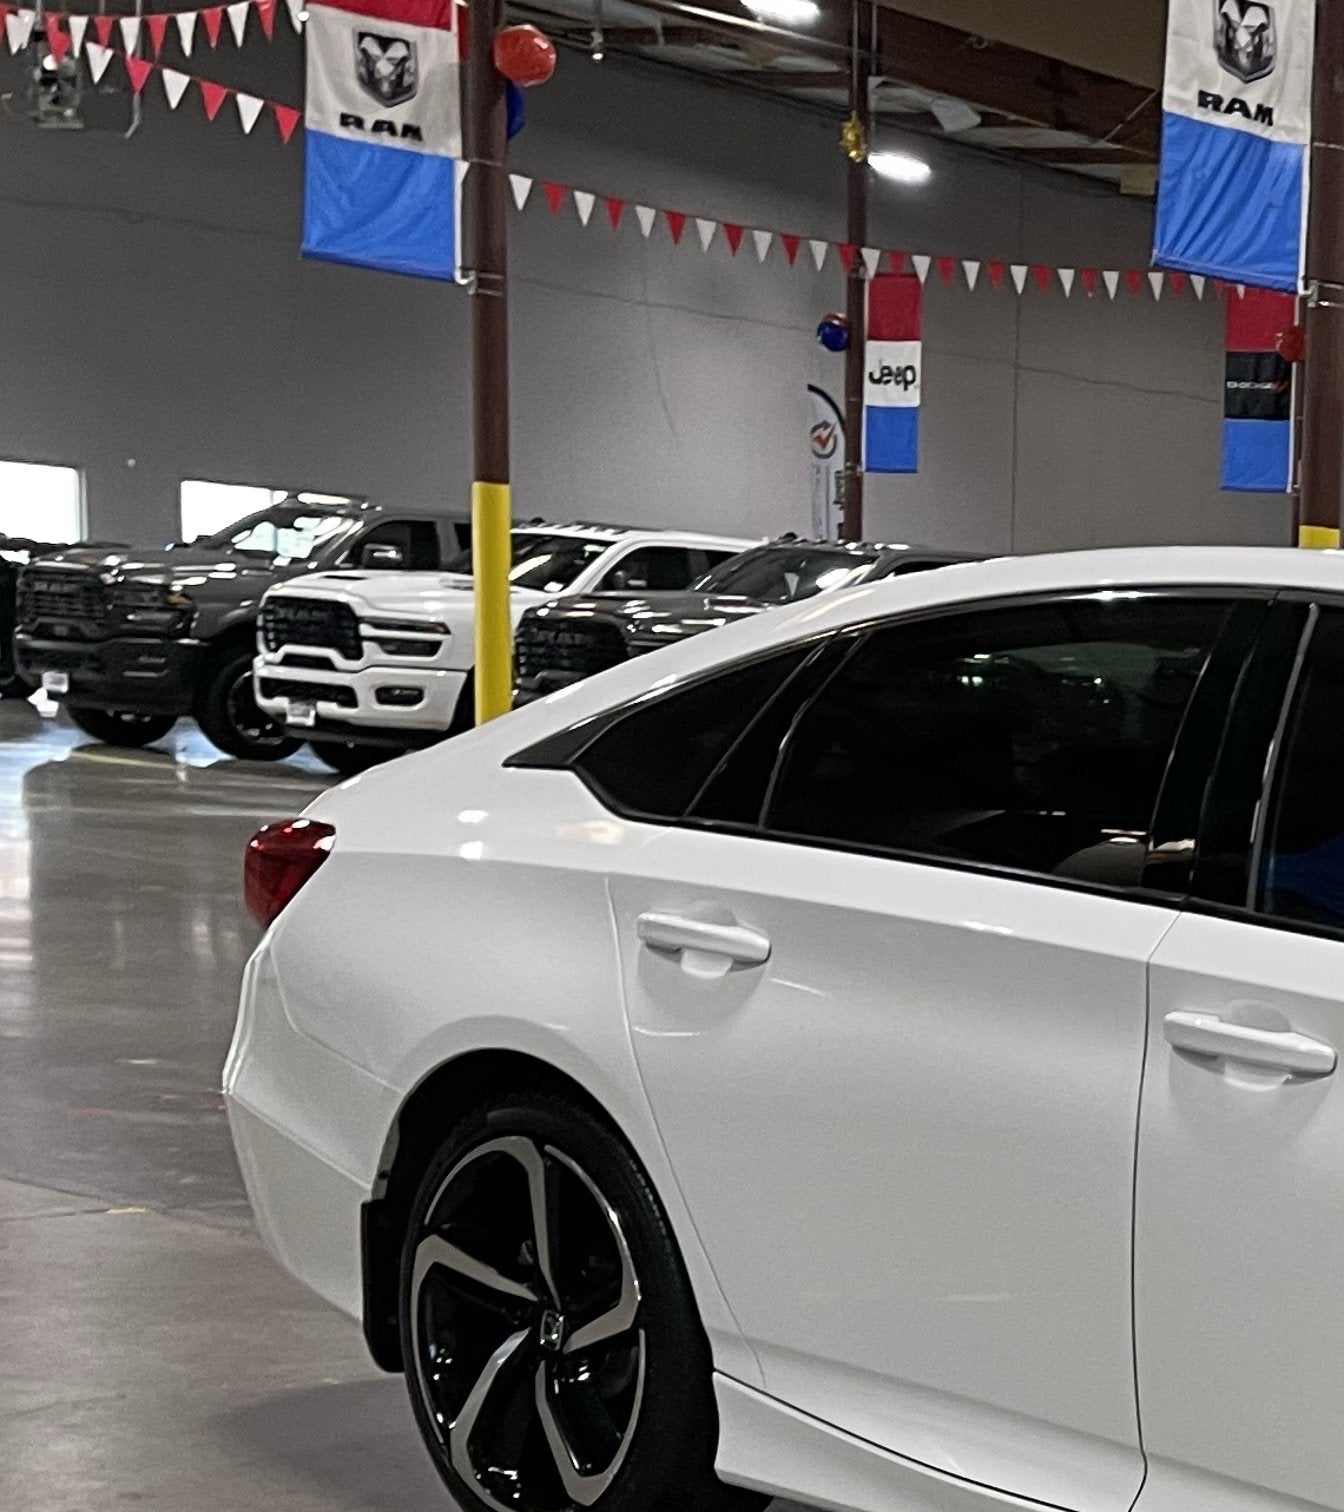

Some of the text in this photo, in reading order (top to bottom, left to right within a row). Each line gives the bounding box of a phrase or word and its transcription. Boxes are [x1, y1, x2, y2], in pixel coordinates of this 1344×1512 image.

[1197, 89, 1273, 127] RAM
[339, 112, 423, 142] RAM
[869, 361, 917, 391] Jeep
